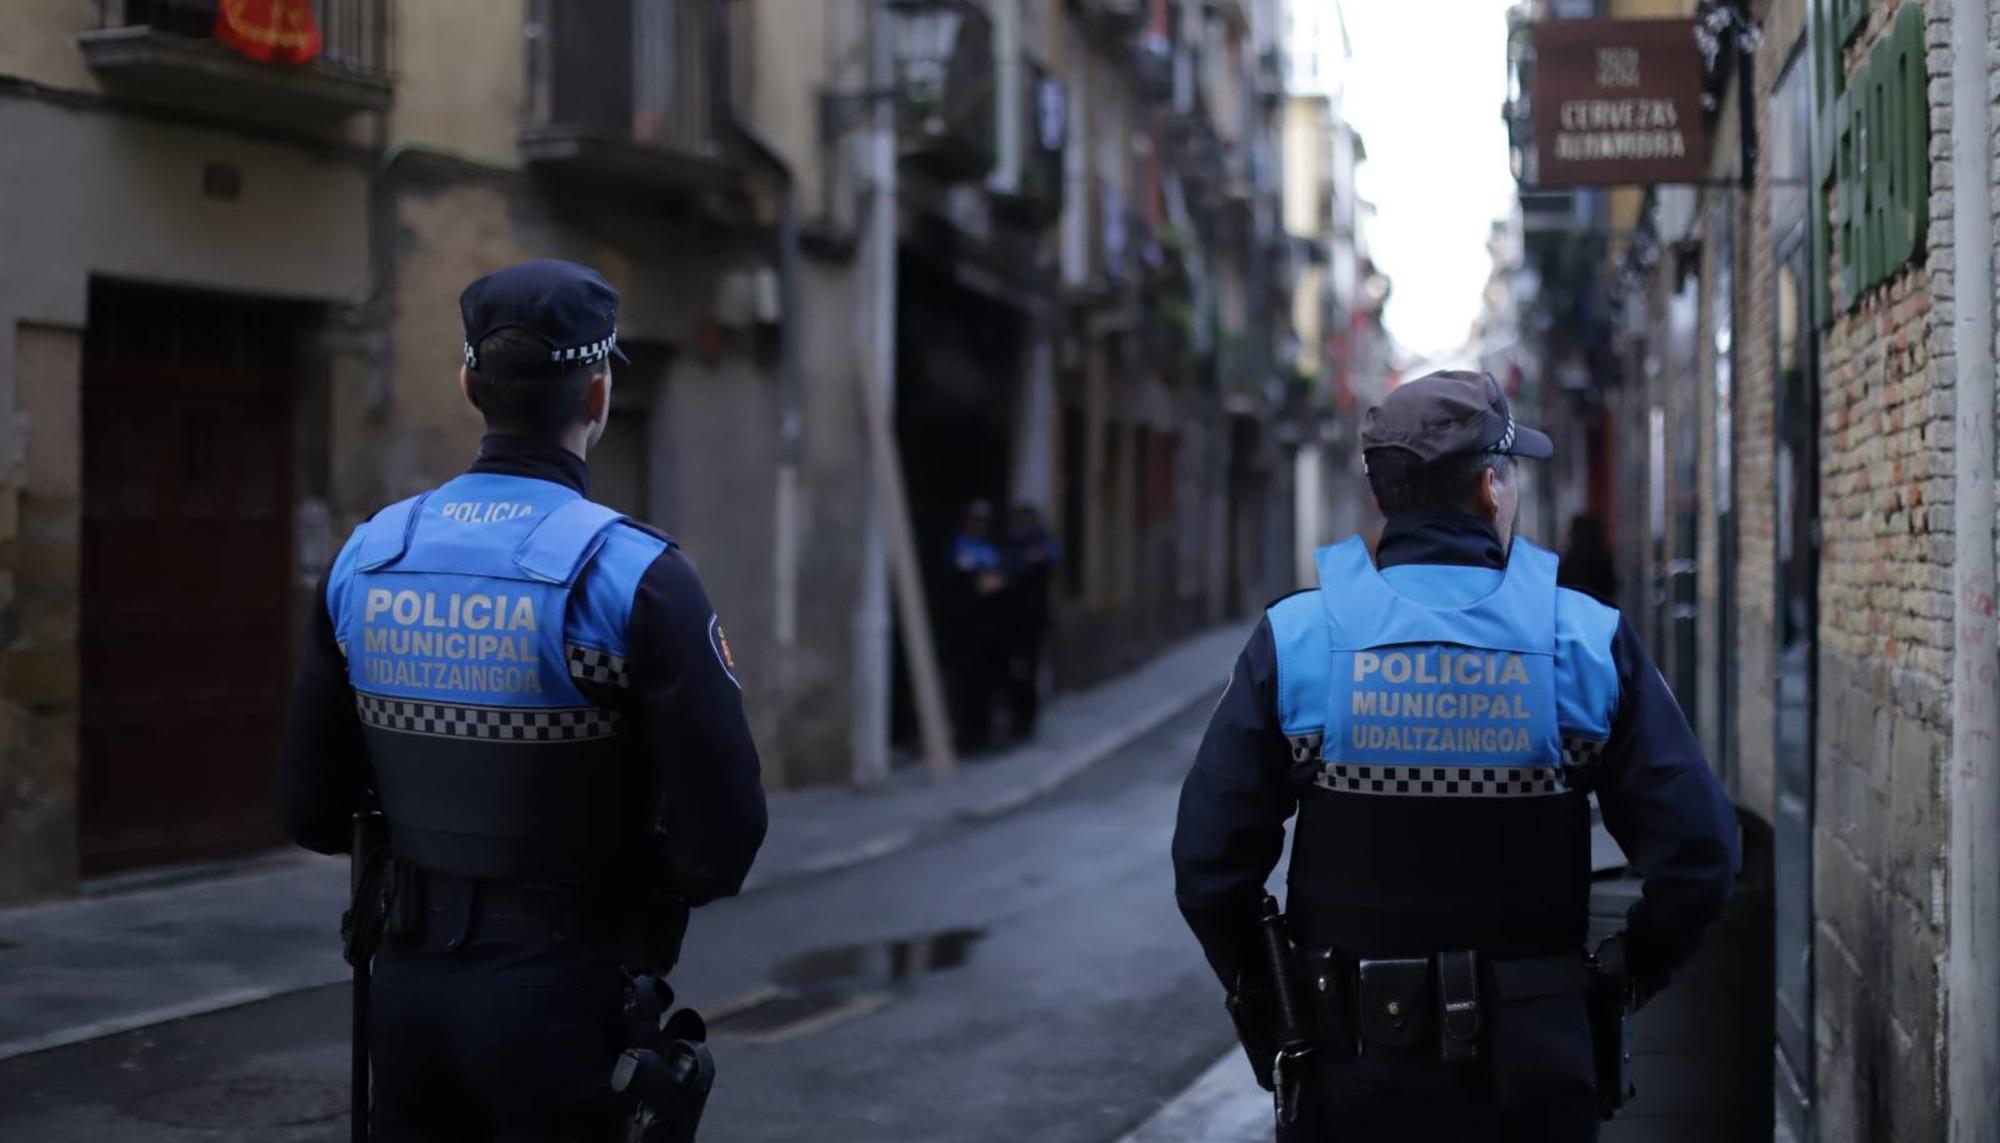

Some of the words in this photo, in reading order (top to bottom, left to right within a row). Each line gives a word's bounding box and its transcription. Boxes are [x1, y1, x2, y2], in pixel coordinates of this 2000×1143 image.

[1560, 98, 1677, 129] CERVEZAS
[365, 588, 537, 631] POLICIA
[364, 627, 539, 663] MUNICIPAL
[364, 656, 541, 693] UDALTZAINGOA
[1353, 652, 1530, 685] POLICIA
[1353, 691, 1531, 720] MUNICIPAL
[1352, 724, 1531, 752] UDALTZAINGOA
